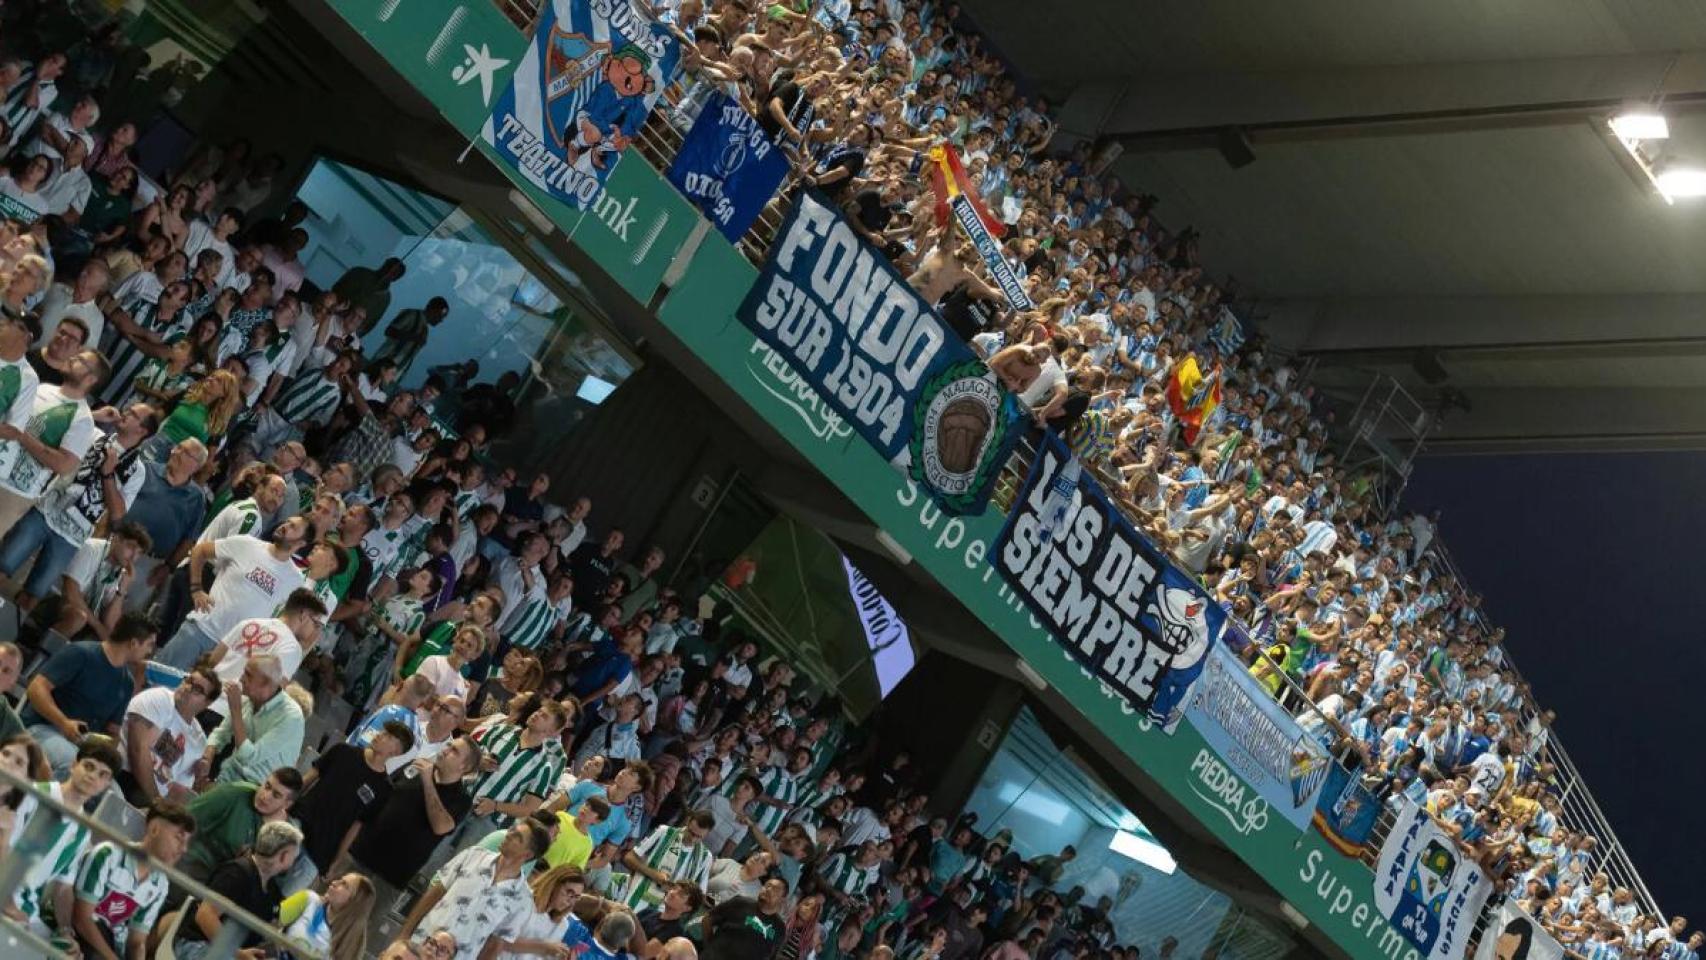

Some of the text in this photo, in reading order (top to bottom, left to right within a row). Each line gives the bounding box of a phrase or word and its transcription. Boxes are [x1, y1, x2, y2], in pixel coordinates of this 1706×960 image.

[756, 273, 905, 446] SUR 1904
[777, 193, 945, 392] FONDO
[1003, 512, 1172, 700] SIEMPRE
[1092, 532, 1156, 620] DE
